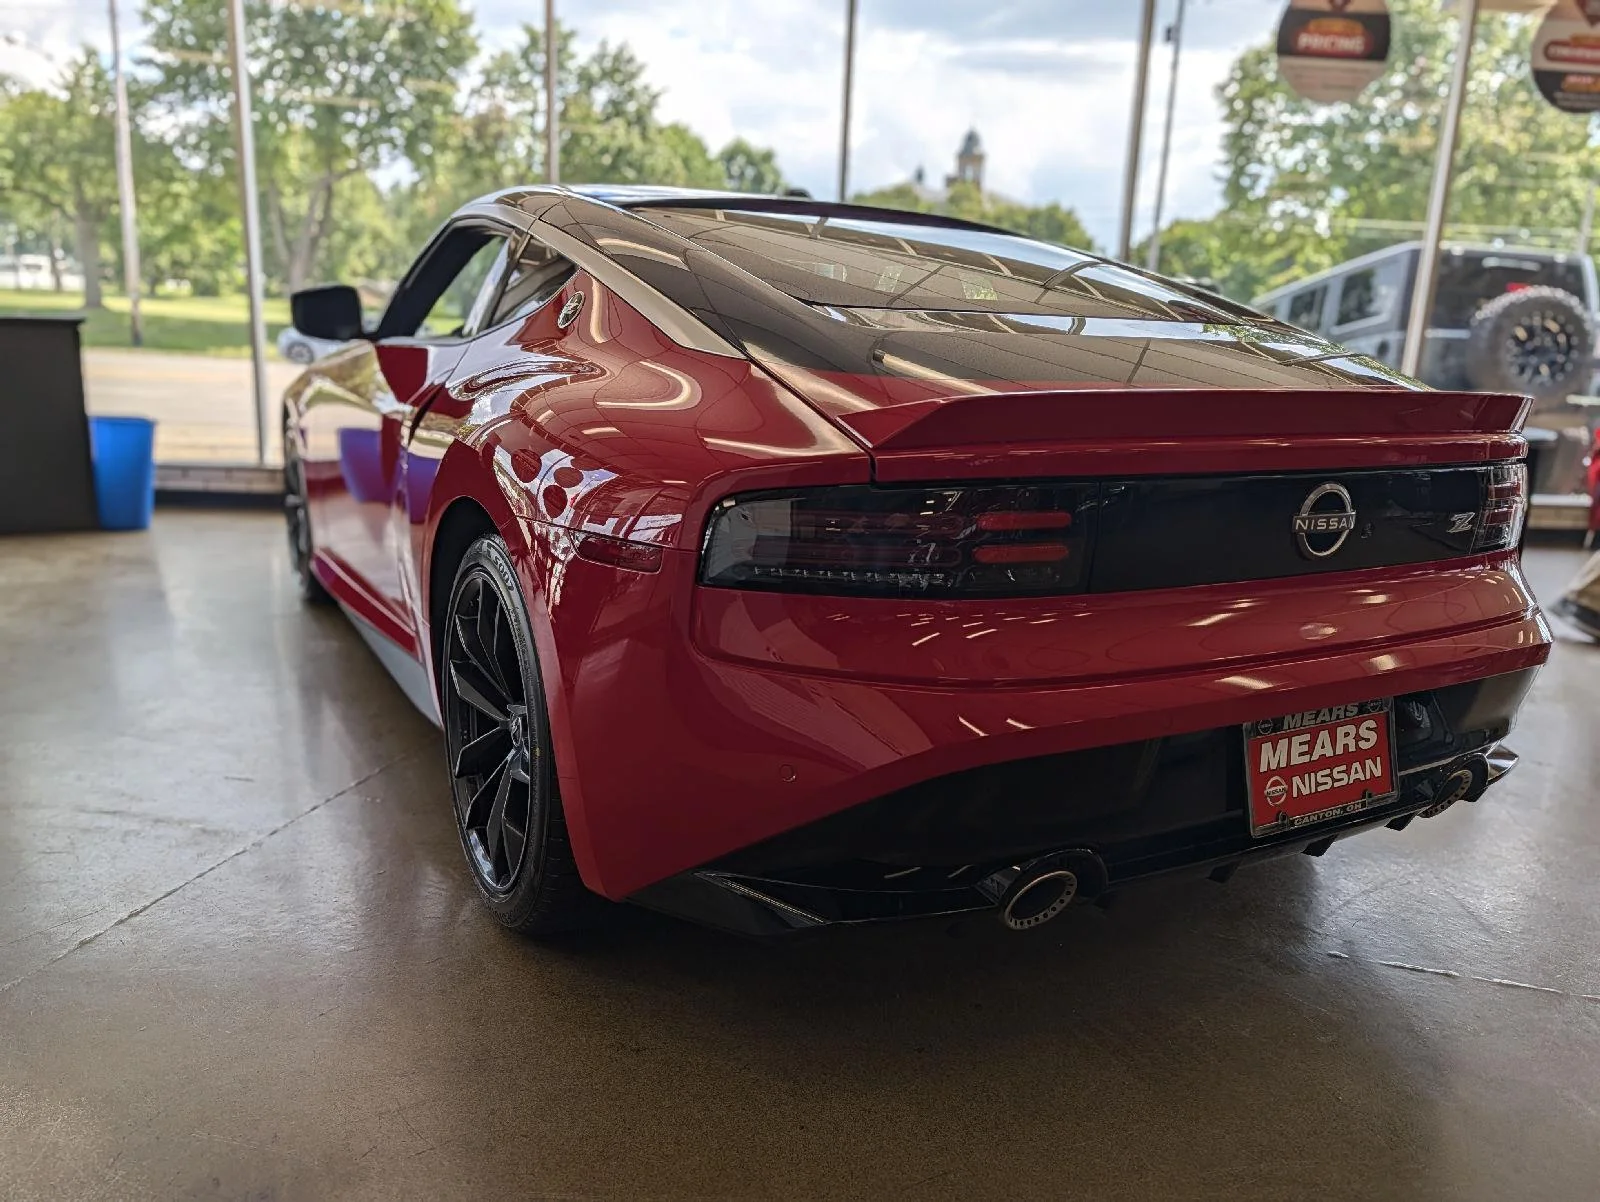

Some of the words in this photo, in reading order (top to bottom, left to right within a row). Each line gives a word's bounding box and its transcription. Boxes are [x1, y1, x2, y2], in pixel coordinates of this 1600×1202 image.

[1282, 702, 1359, 730] MEARS
[1259, 719, 1378, 773] MEARS
[1292, 756, 1382, 798] NISSAN
[1294, 809, 1344, 826] CANTON,
[1346, 803, 1362, 812] OH
